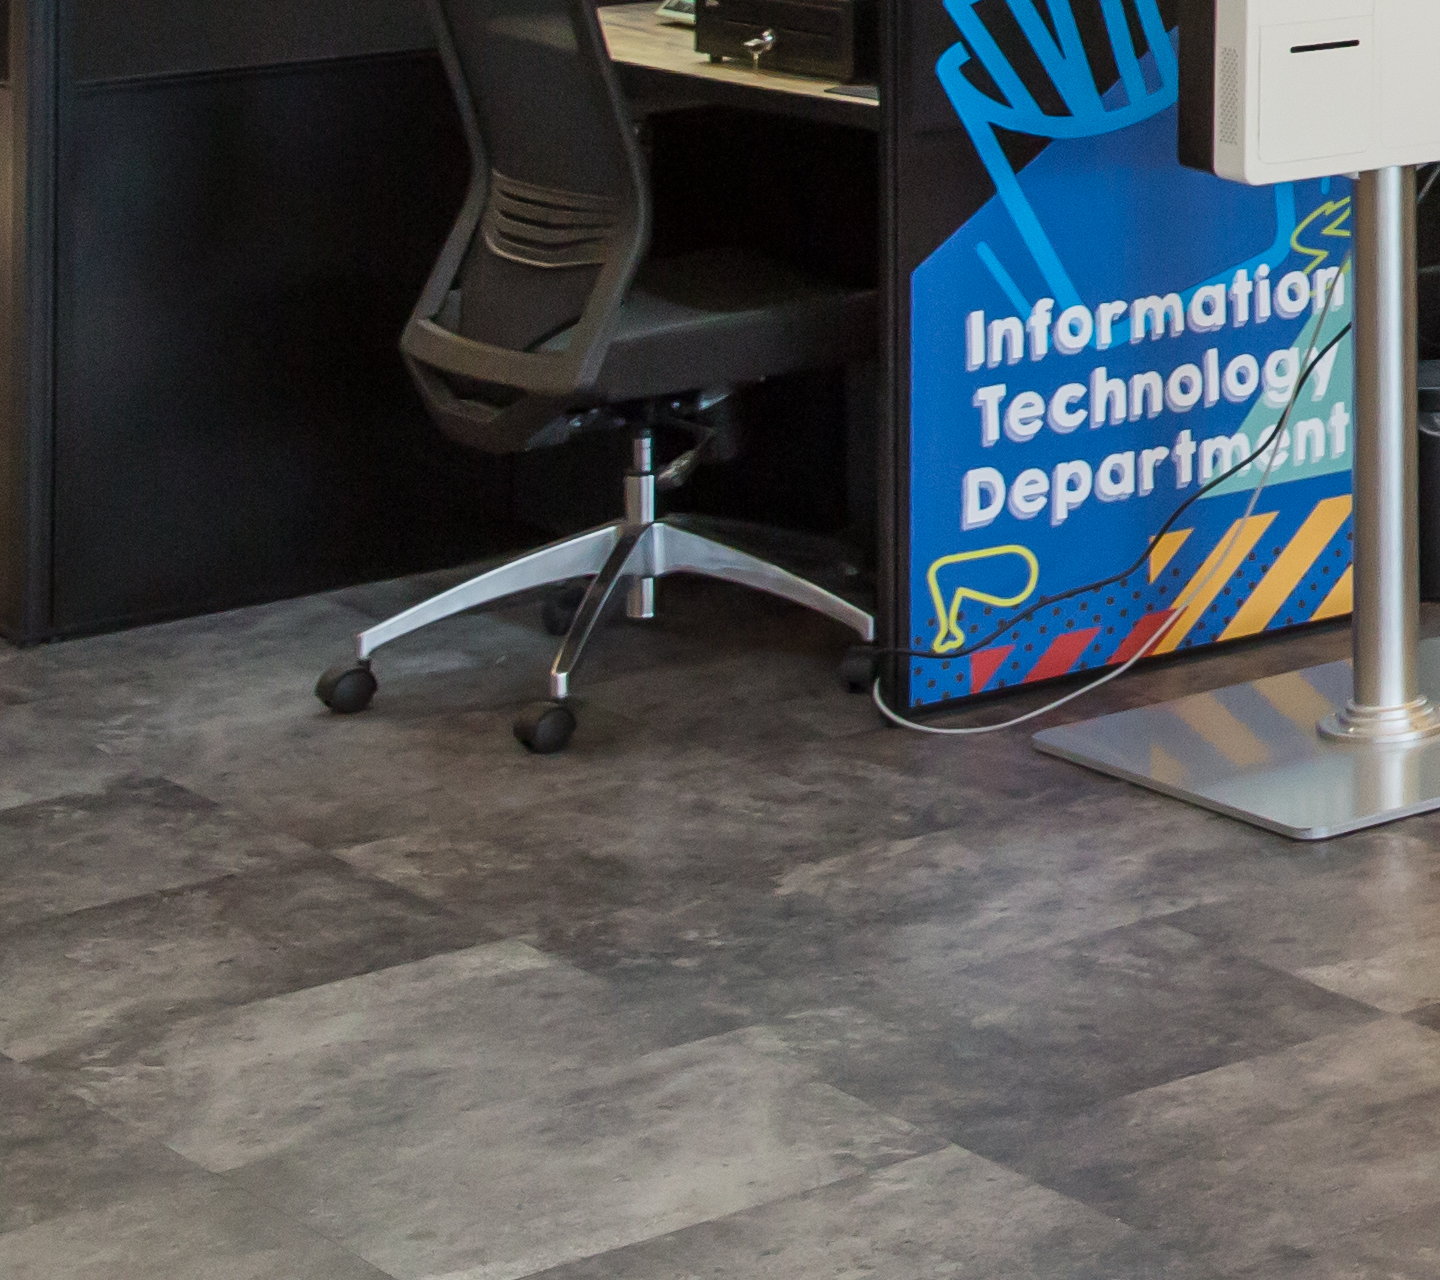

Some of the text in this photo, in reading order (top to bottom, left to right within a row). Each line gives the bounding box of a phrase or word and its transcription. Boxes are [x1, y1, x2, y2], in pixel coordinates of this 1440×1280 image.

[965, 262, 1347, 372] Information
[972, 322, 1342, 446] Technology
[962, 400, 1350, 531] Department
